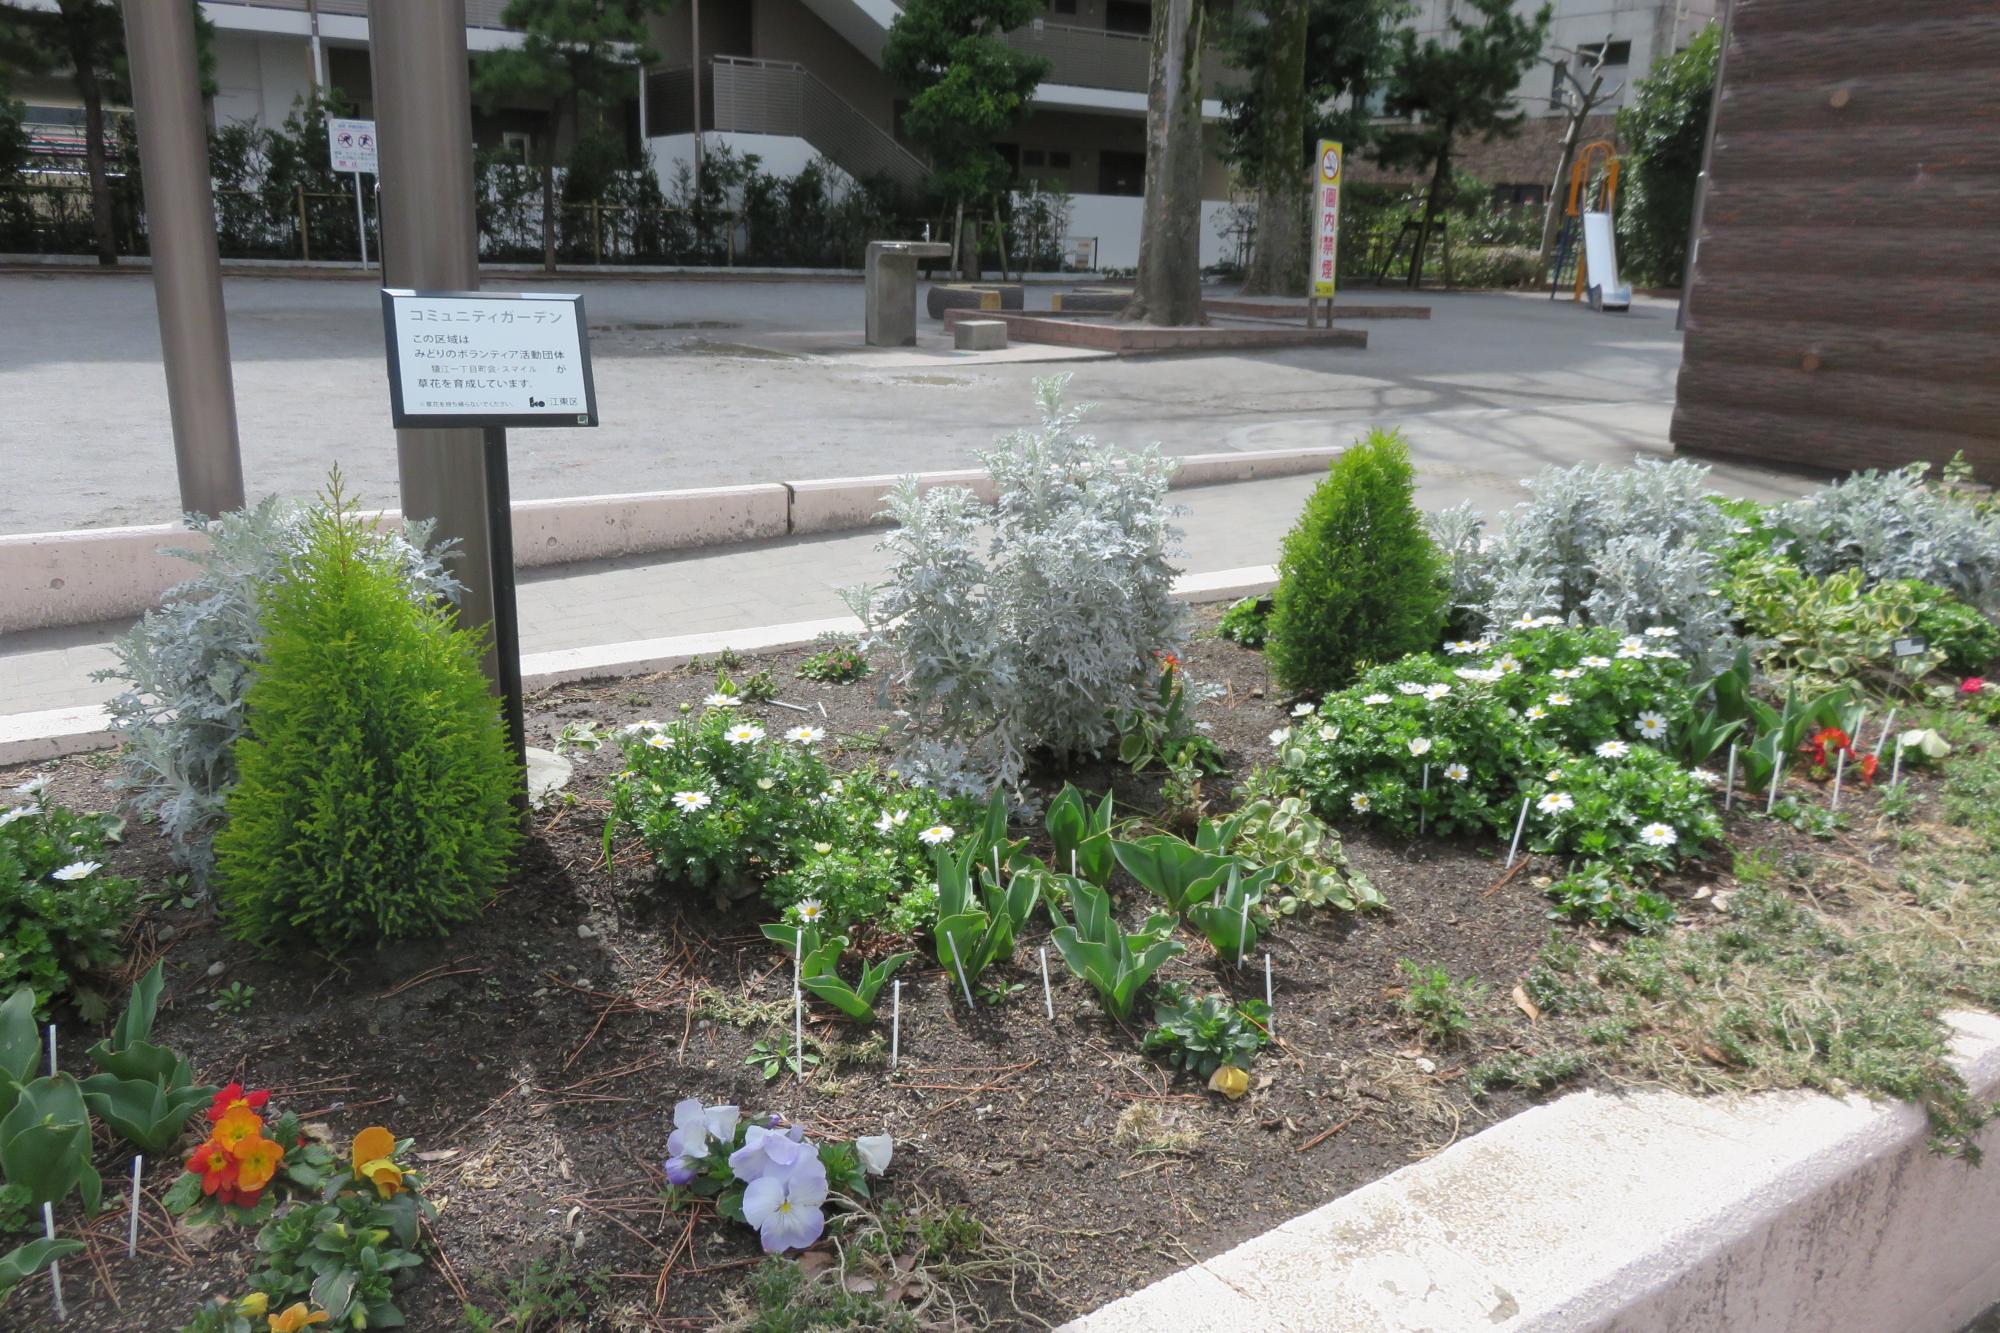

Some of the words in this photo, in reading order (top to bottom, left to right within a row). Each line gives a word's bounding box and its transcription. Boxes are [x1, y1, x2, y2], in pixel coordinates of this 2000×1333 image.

[410, 309, 562, 324] コミュニティガーデン
[413, 334, 469, 345] この区域は
[414, 349, 565, 360] みどりのボランティア活動団体
[556, 364, 567, 375] が
[418, 378, 534, 389] 草花を育成しています。
[549, 397, 577, 406] 江東区
